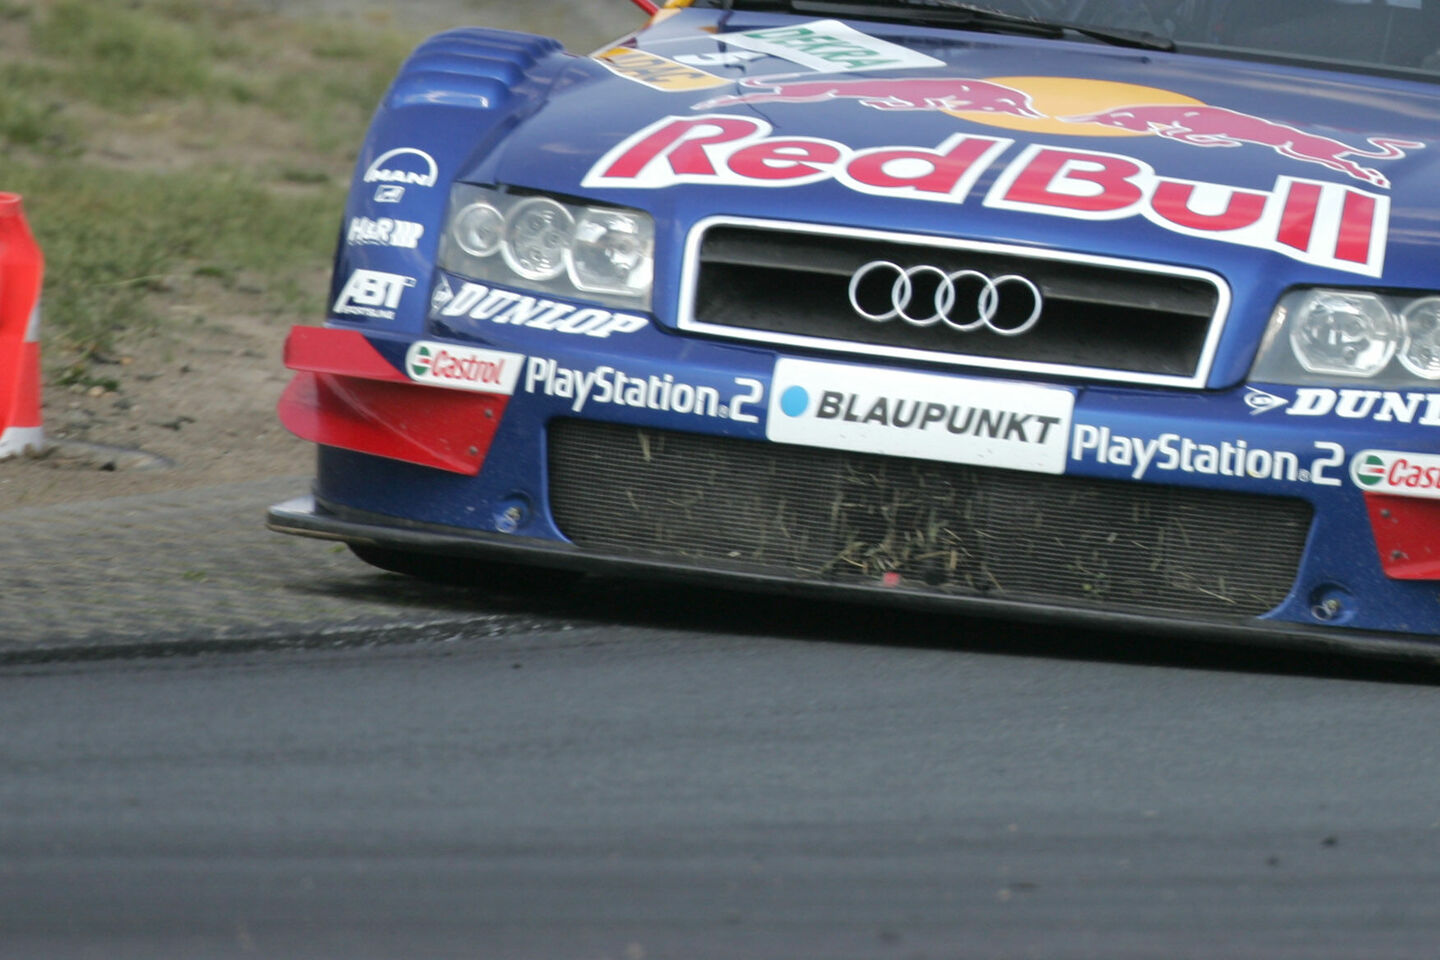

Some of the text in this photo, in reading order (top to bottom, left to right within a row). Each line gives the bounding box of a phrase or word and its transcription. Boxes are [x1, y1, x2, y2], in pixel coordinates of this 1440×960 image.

[745, 27, 904, 70] DEKRA
[363, 167, 435, 188] MAN
[579, 115, 1391, 279] Red Bull
[332, 268, 405, 314] ABT
[442, 282, 650, 338] DUNLOP
[430, 349, 506, 386] Castrol
[525, 355, 720, 413] PlayStation
[814, 389, 1061, 445] BLAUPUNKT
[1071, 423, 1299, 480] PlayStation
